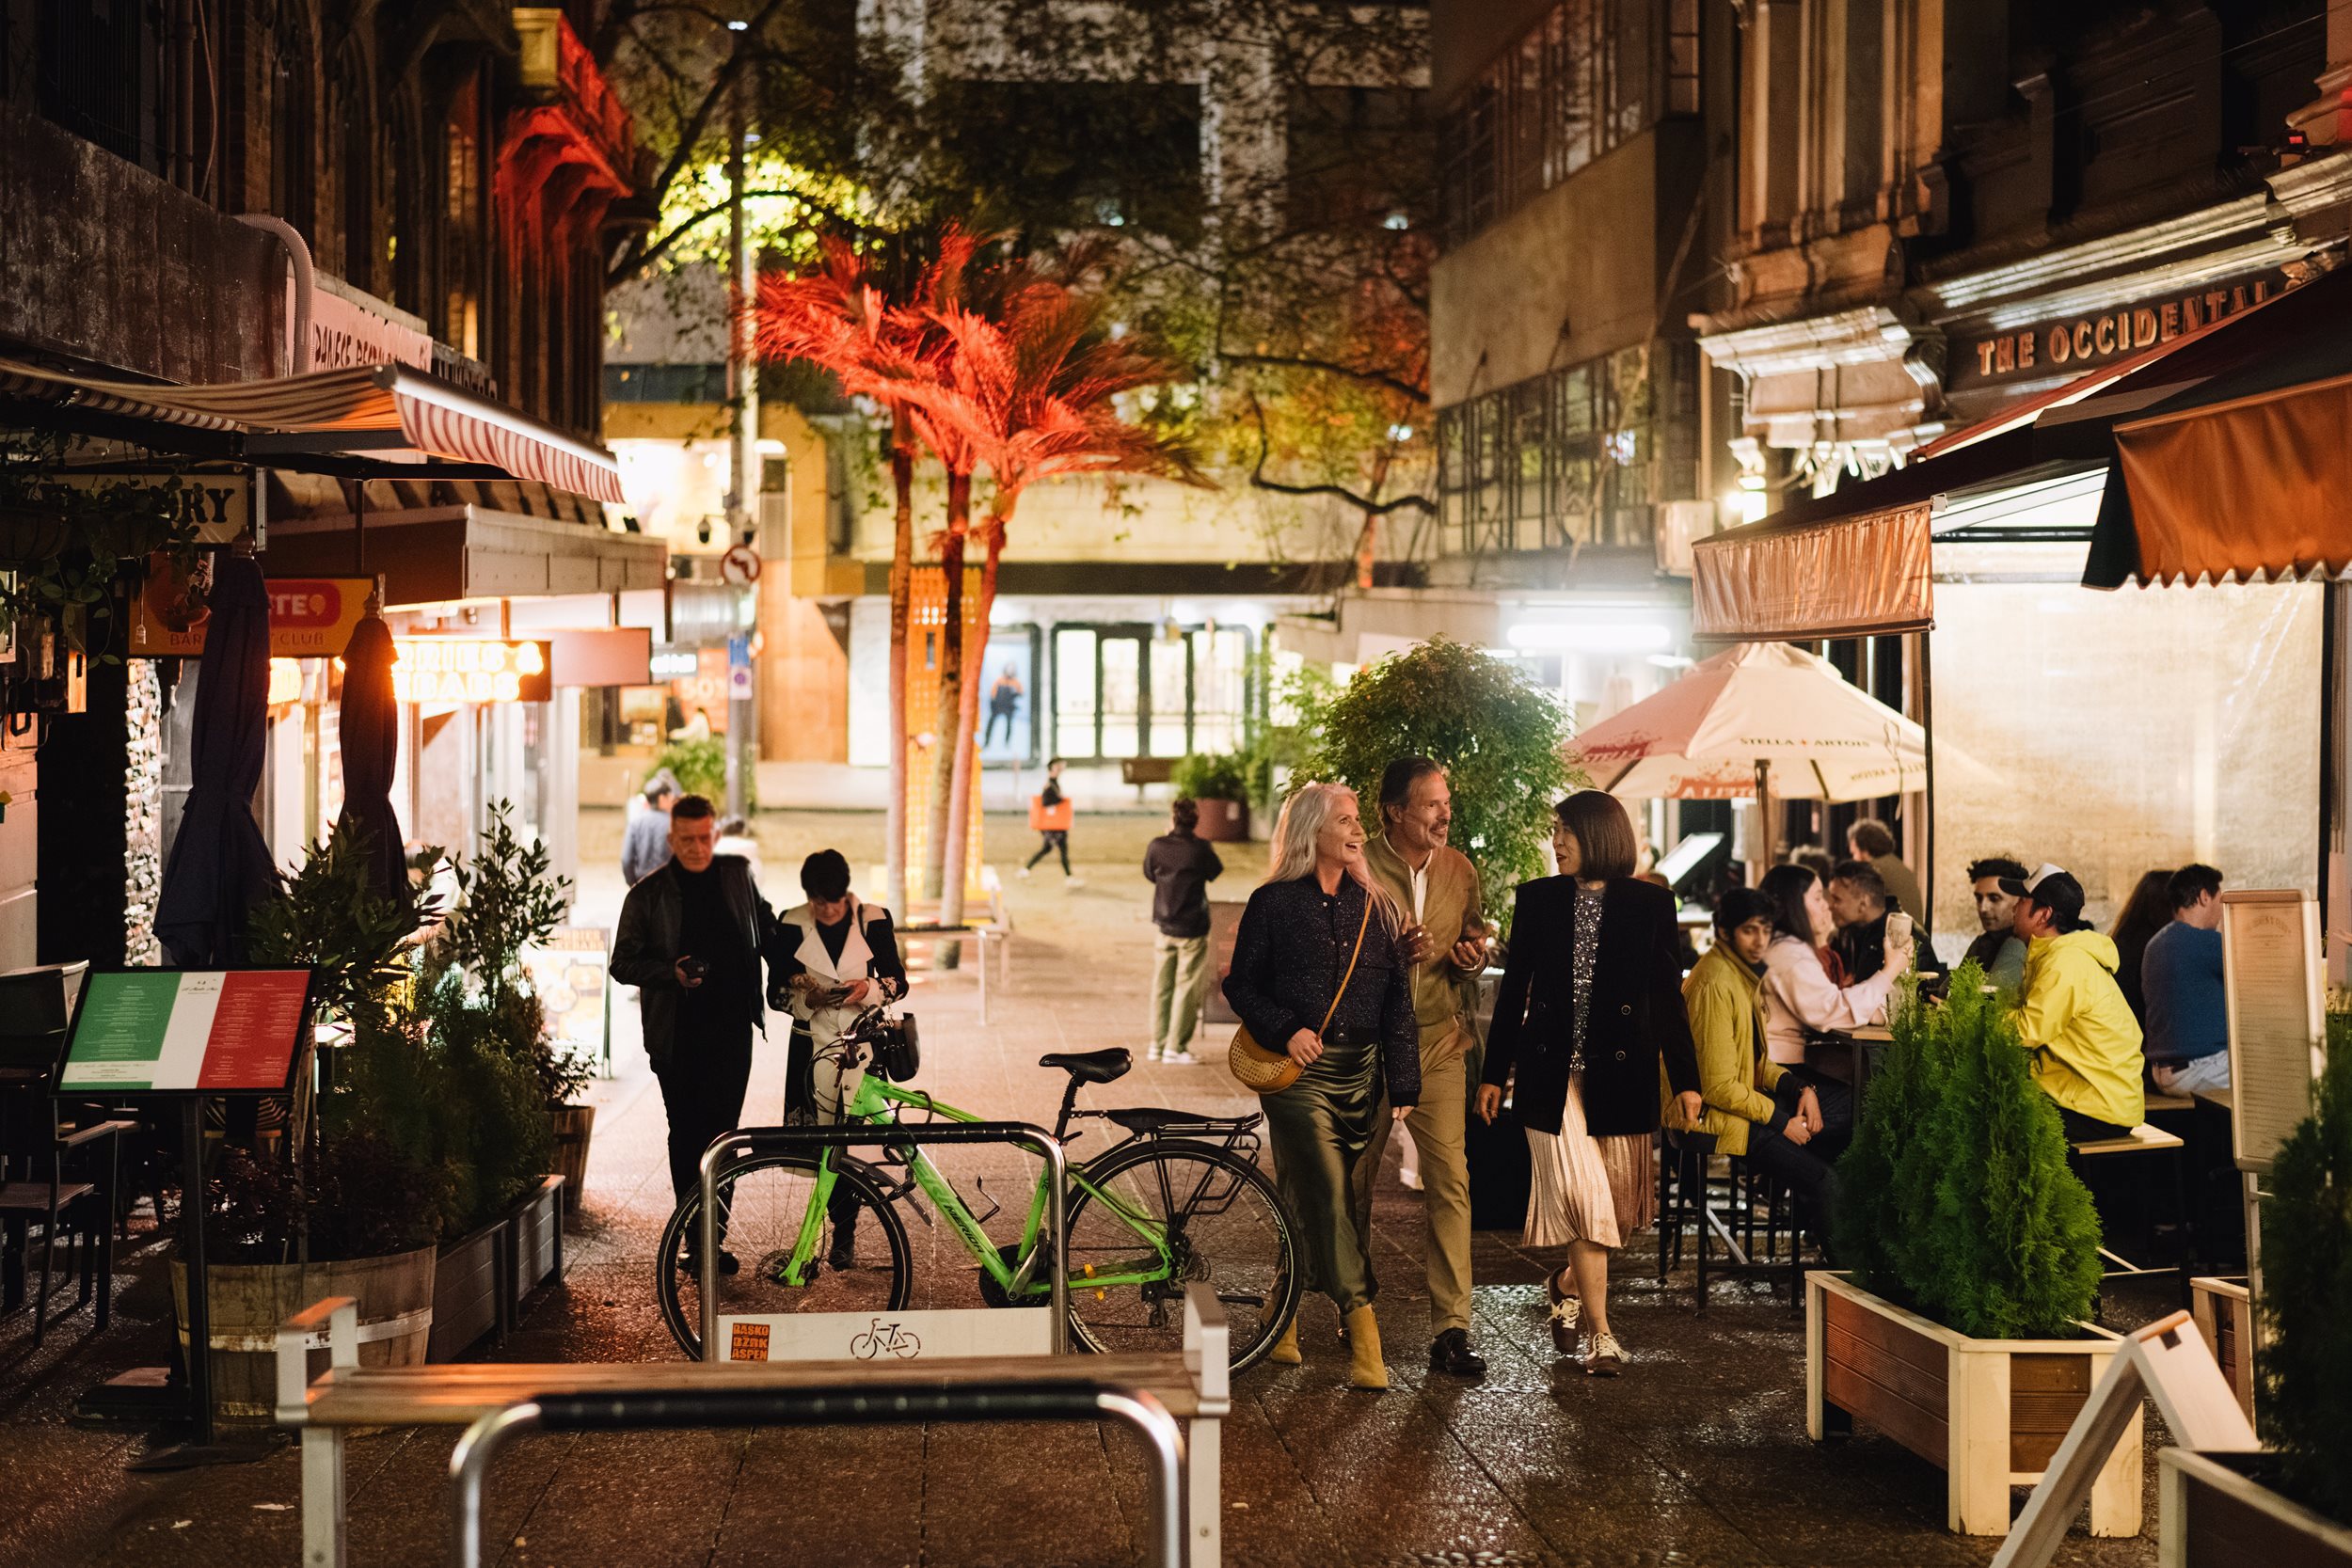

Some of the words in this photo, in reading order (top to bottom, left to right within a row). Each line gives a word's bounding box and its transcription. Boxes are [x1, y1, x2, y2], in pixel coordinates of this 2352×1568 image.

[1978, 331, 2034, 376] THE
[1740, 737, 1795, 747] STELLA
[1814, 738, 1870, 748] ARTOIS
[944, 1204, 985, 1254] MERIDA
